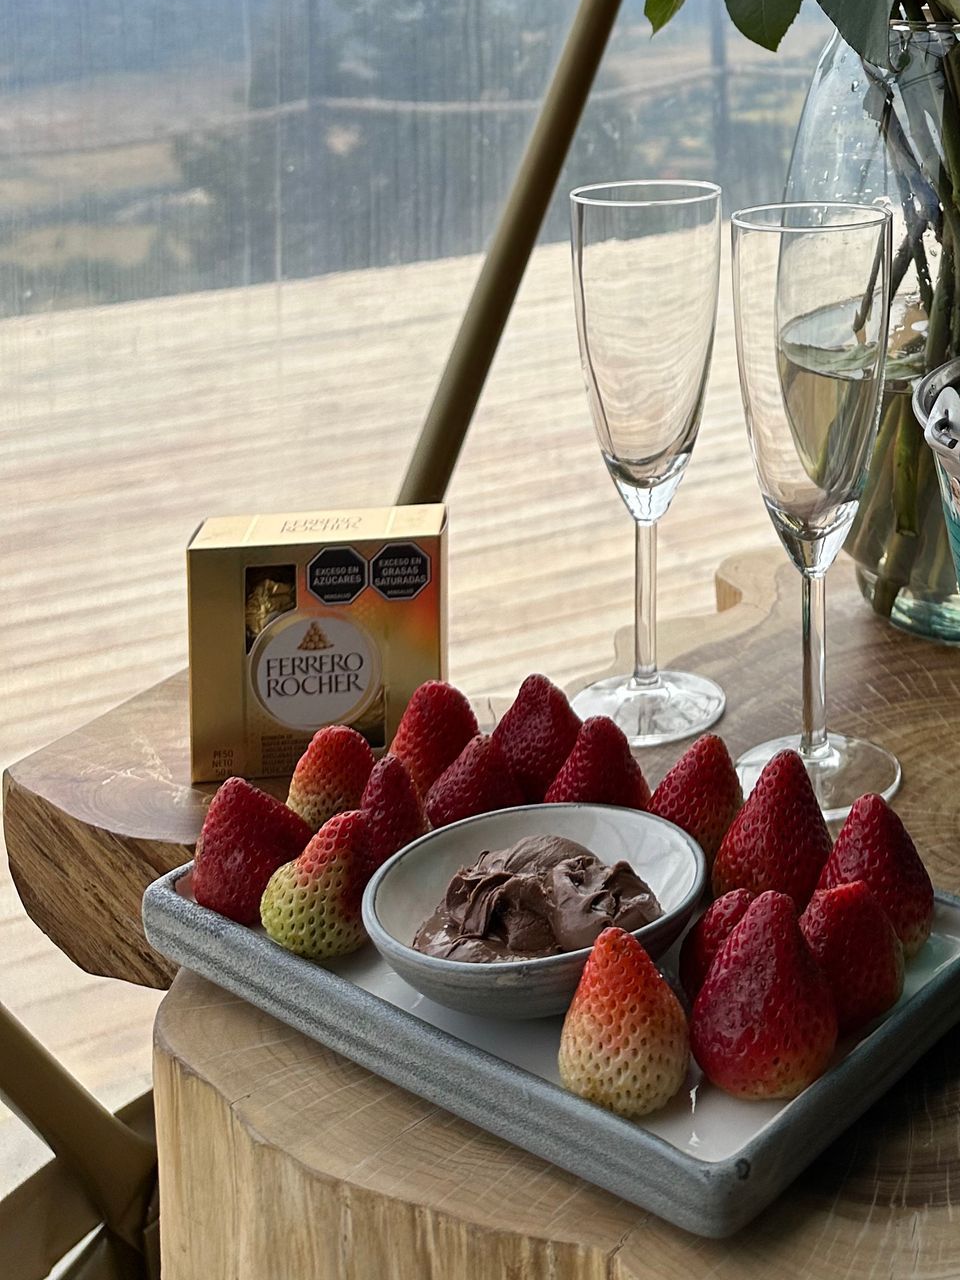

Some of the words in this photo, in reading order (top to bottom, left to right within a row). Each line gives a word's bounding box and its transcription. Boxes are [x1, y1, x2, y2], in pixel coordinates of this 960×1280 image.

[380, 558, 409, 567] EXCESO
[410, 557, 421, 565] EN
[316, 567, 345, 576] EXCESO
[348, 566, 359, 574] EN
[382, 566, 419, 576] GRASAS
[313, 574, 361, 586] AZÚCARES
[375, 575, 426, 587] SATURADAS
[266, 652, 363, 677] FERRERO
[266, 673, 364, 698] ROCHER
[213, 750, 234, 759] PESO
